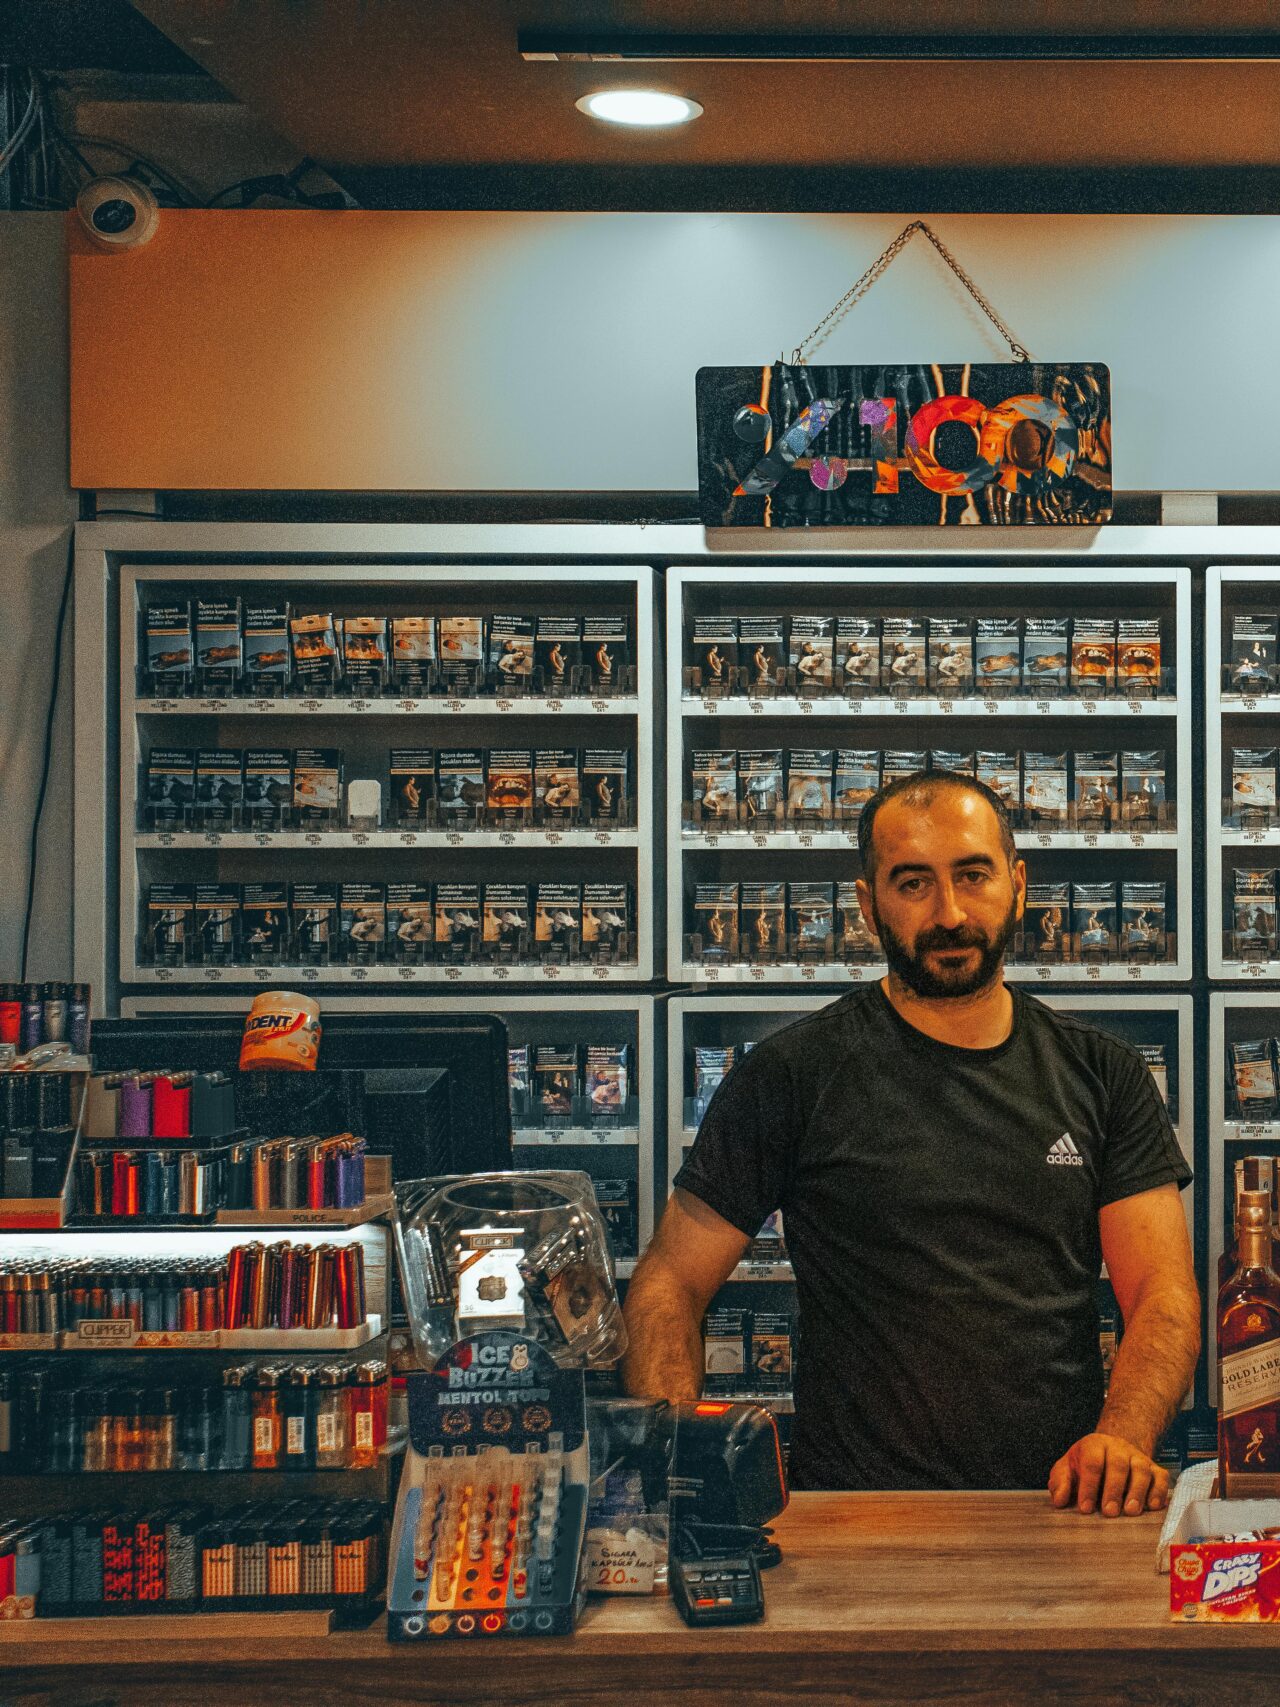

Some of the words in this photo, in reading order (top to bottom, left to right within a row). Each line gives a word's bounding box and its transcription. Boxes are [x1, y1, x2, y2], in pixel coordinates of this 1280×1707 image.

[1047, 1153, 1083, 1166] adidas
[292, 1213, 327, 1223] POLICE
[83, 1324, 127, 1338] CLIPPER
[471, 1343, 511, 1365] ICE
[1222, 1370, 1251, 1386] GOLD
[438, 1390, 501, 1406] MENTOL
[1213, 1552, 1262, 1571] CRAZY
[1202, 1562, 1261, 1601] DIPS
